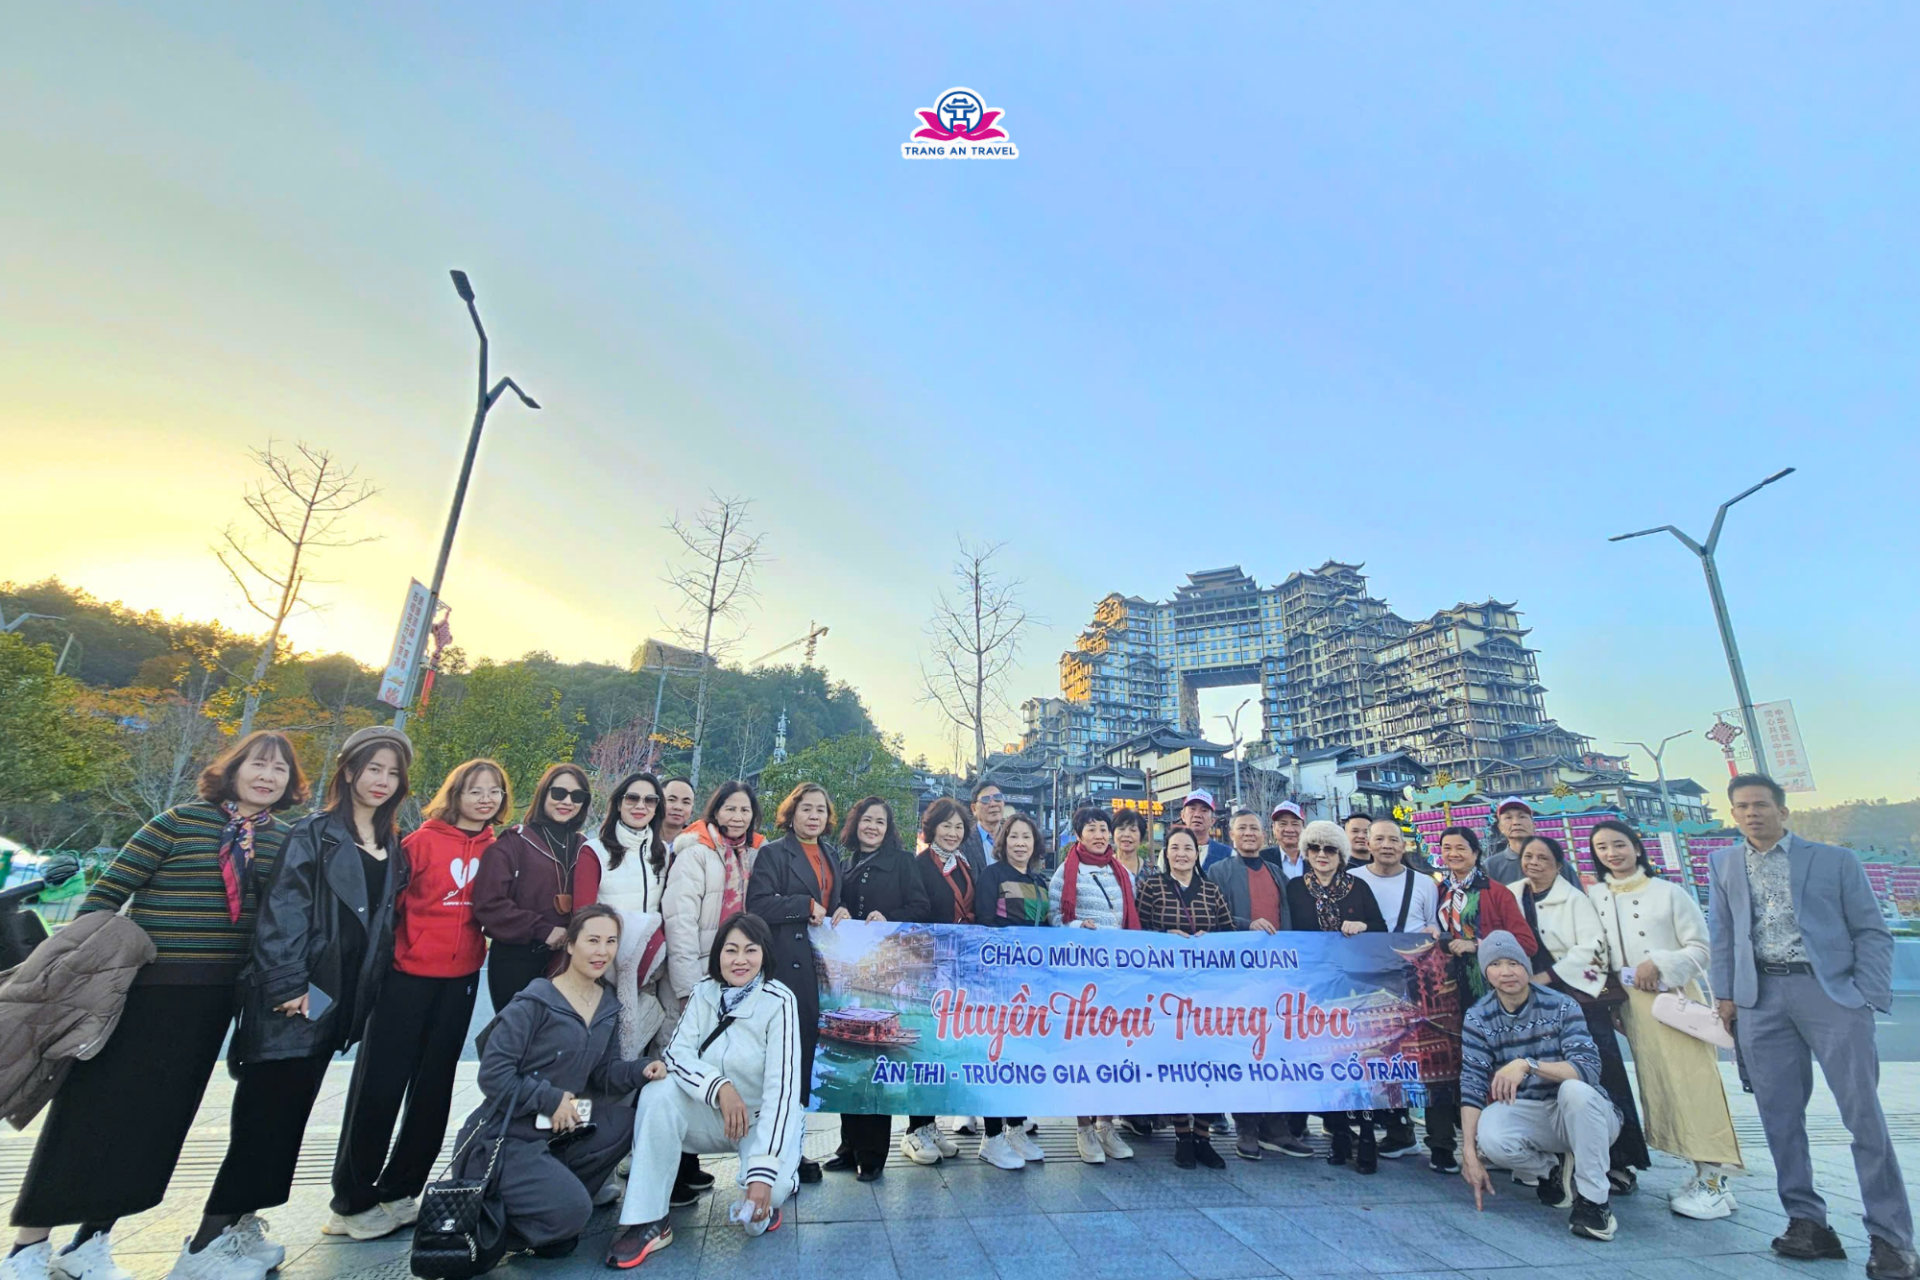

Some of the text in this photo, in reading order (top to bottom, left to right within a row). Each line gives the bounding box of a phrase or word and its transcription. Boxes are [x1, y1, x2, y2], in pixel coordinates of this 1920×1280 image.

[981, 941, 1298, 969] CHÀO MỪNG ĐOÀN THAM QUAN
[932, 983, 1354, 1062] Huyền Thoại Trung Hoa
[872, 1056, 906, 1084] ÂN
[913, 1063, 945, 1084] THI
[961, 1062, 1047, 1085] TRƯƠNG
[1052, 1064, 1092, 1084] GIA
[1096, 1059, 1142, 1084] GIỚI
[1157, 1061, 1243, 1088] PHƯỢNG
[1248, 1057, 1325, 1082] HOÀNG
[1330, 1052, 1364, 1082] CỔ
[1367, 1053, 1419, 1081] TRẤN
